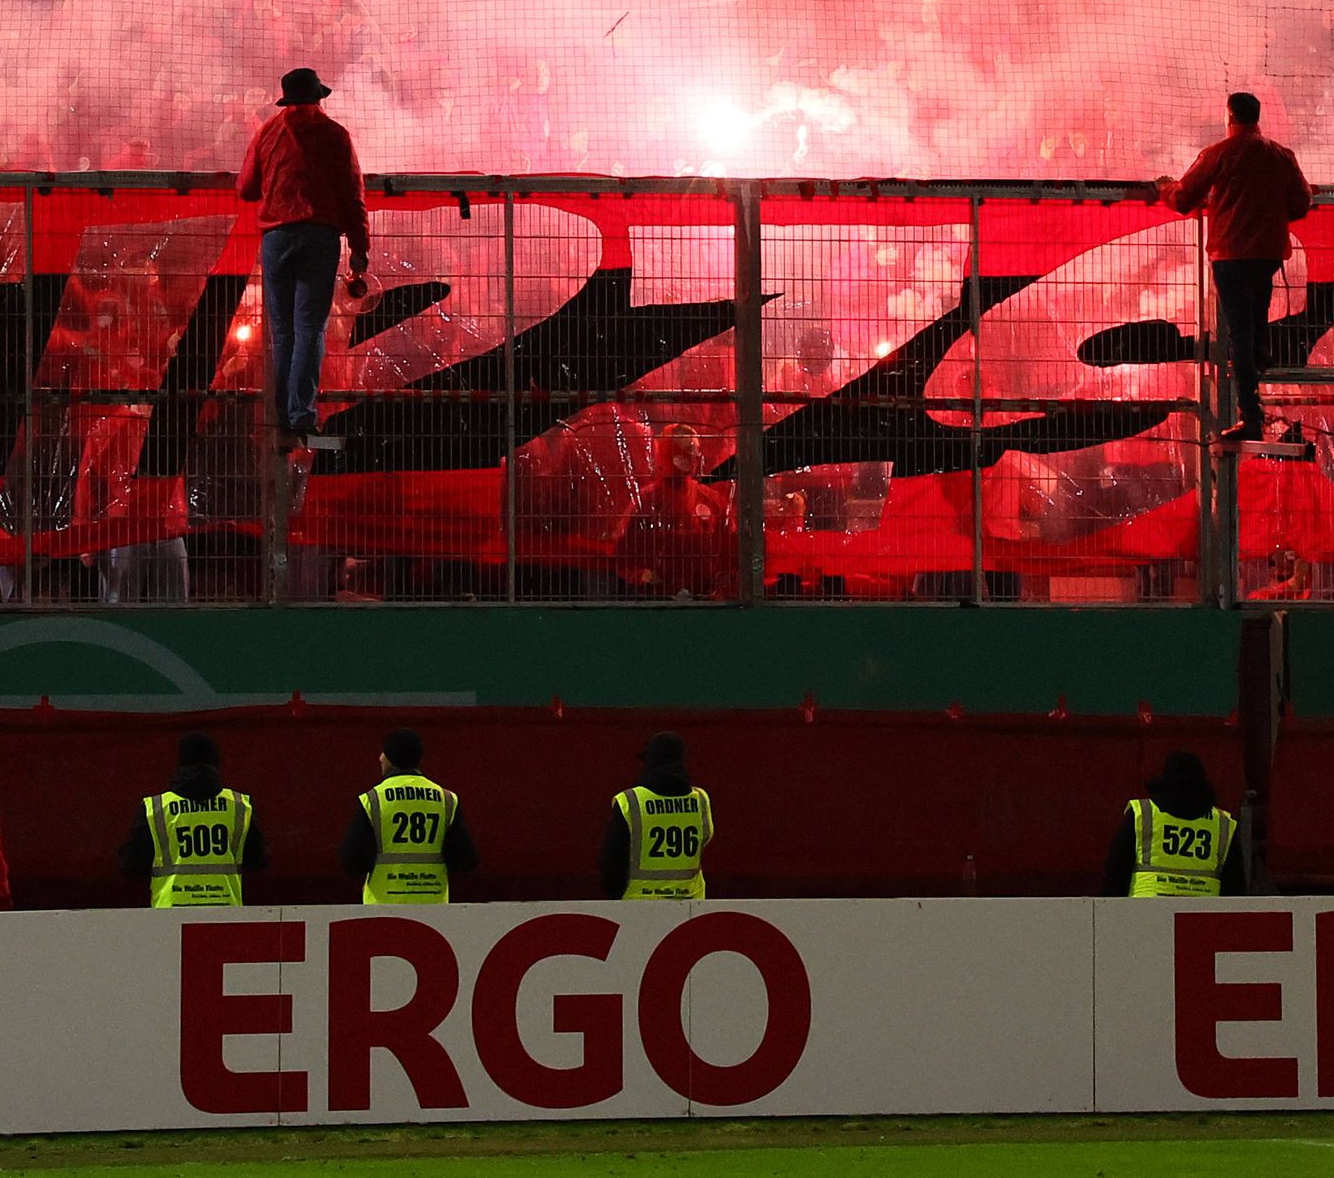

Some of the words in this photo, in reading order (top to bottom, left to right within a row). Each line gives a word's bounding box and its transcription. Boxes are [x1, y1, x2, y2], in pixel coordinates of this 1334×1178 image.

[169, 796, 228, 816] ORDNER
[384, 786, 442, 803] ORDNER
[644, 797, 699, 815] ORDNER
[175, 823, 228, 858] 509
[391, 811, 440, 844] 287
[648, 825, 700, 858] 296
[1162, 824, 1212, 860] 523
[180, 911, 812, 1115] ERGO
